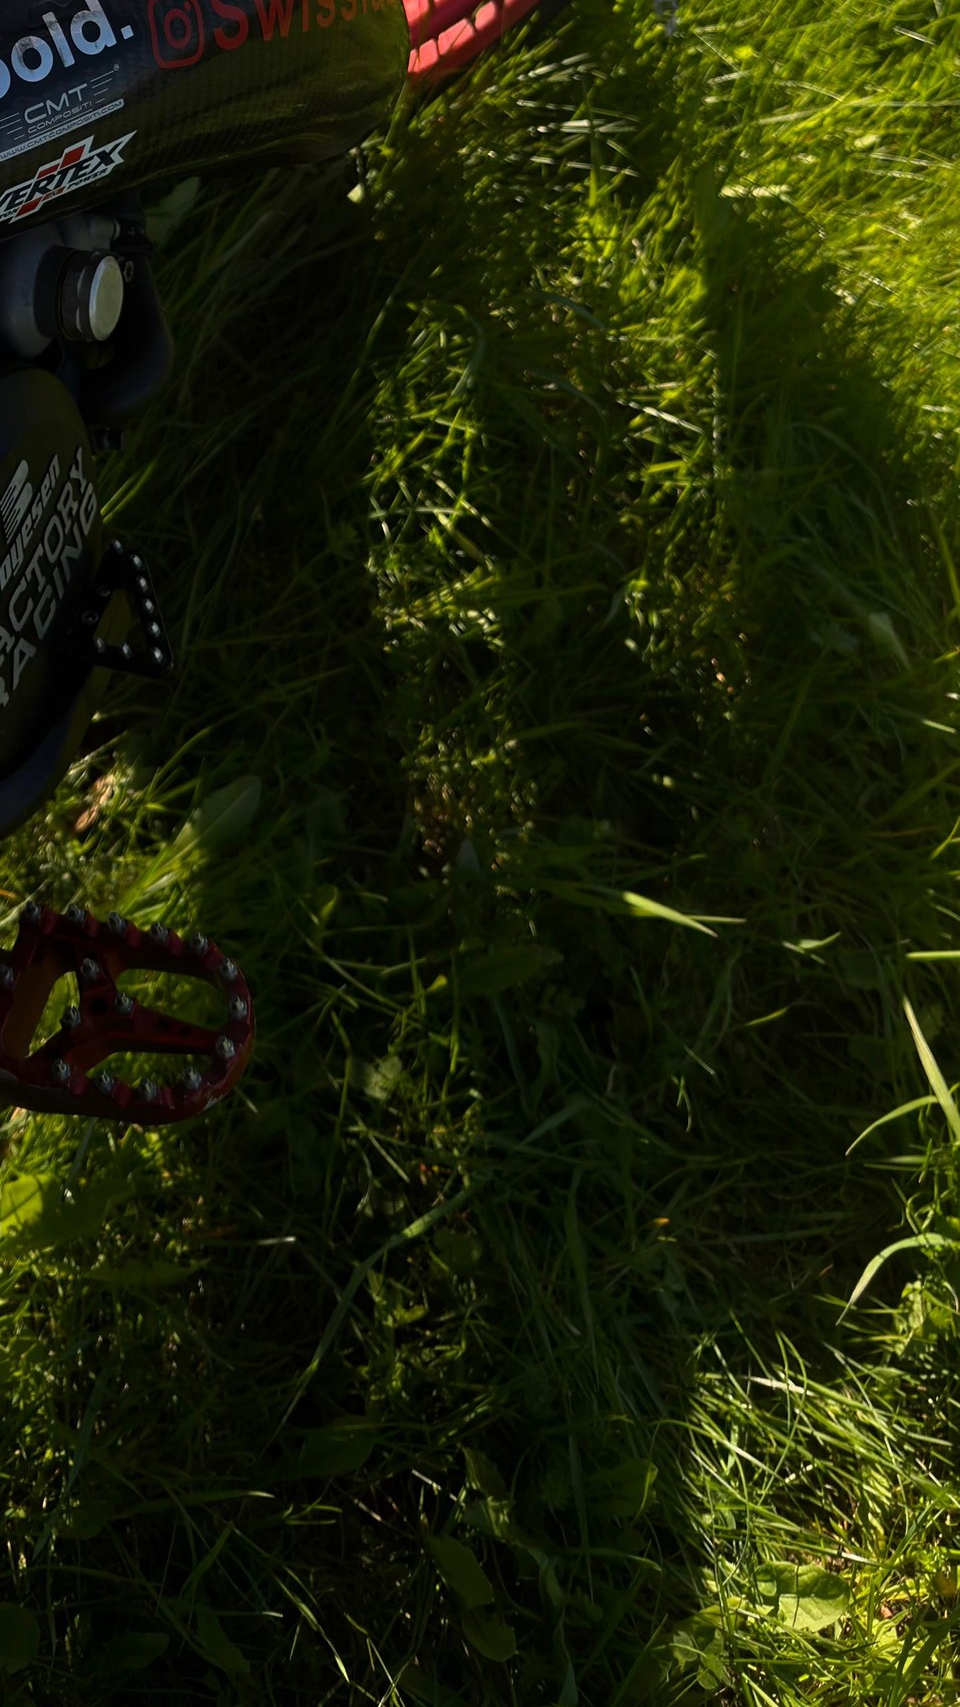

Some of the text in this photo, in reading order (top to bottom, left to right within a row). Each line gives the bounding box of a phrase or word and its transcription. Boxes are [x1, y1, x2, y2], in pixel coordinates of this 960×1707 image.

[24, 82, 88, 124] CMT
[27, 100, 93, 134] COMPOSITI
[0, 100, 123, 161] WWW.CMTCOMPOSITI.COM
[67, 166, 109, 190] POWER
